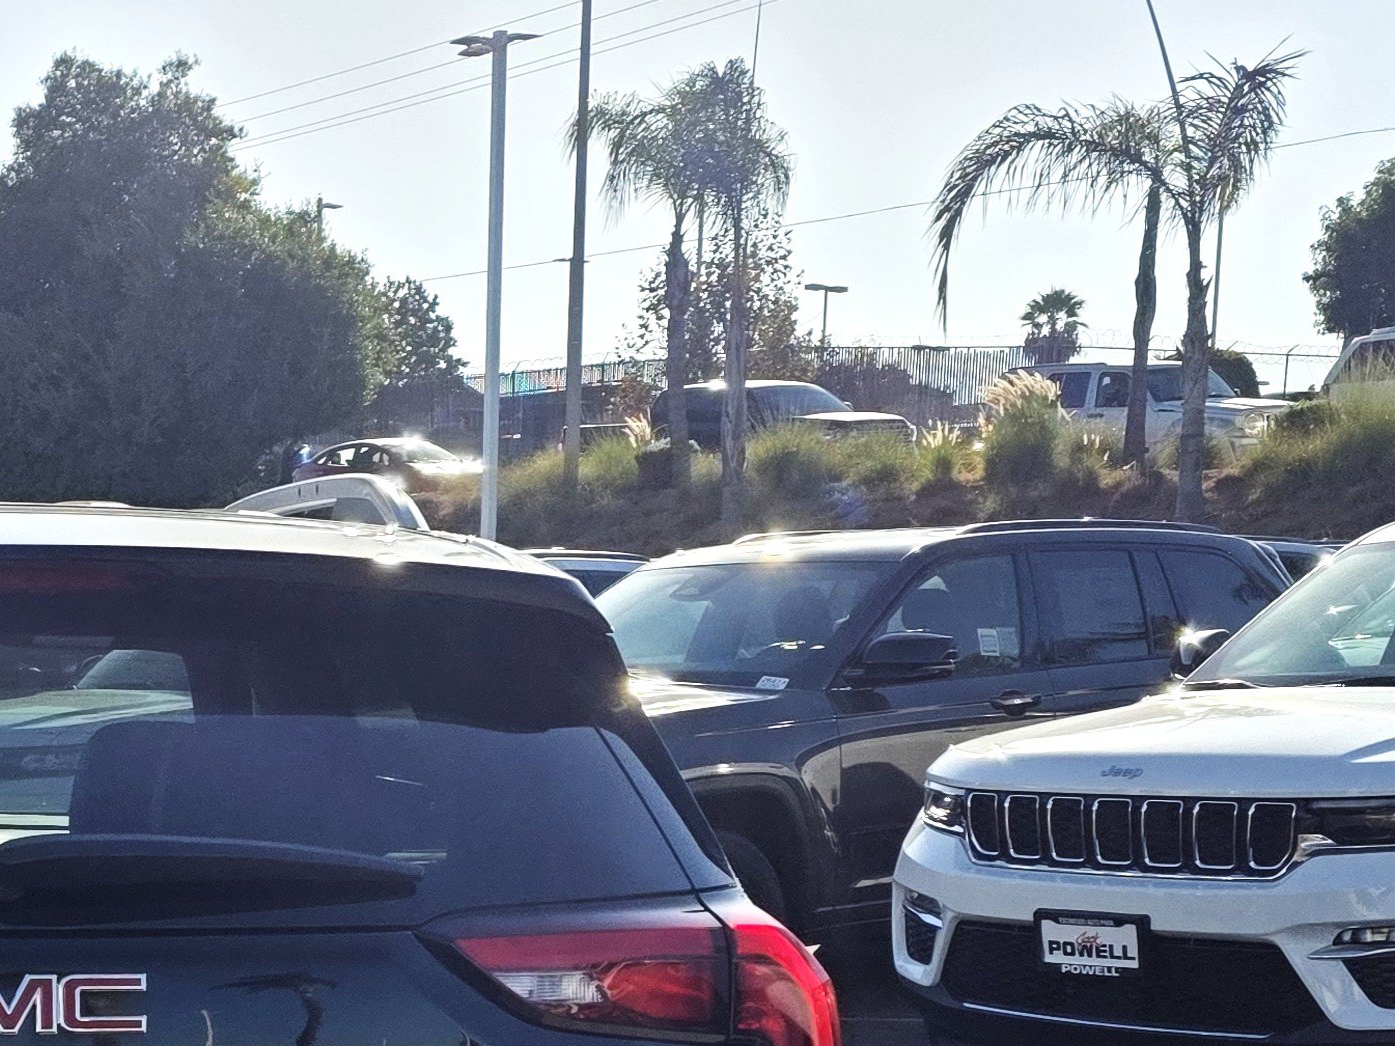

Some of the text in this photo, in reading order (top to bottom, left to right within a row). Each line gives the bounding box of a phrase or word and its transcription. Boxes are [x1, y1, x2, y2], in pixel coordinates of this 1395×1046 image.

[1100, 765, 1144, 780] Jeep
[1048, 940, 1136, 961] POWELL
[1061, 964, 1120, 977] POWELL
